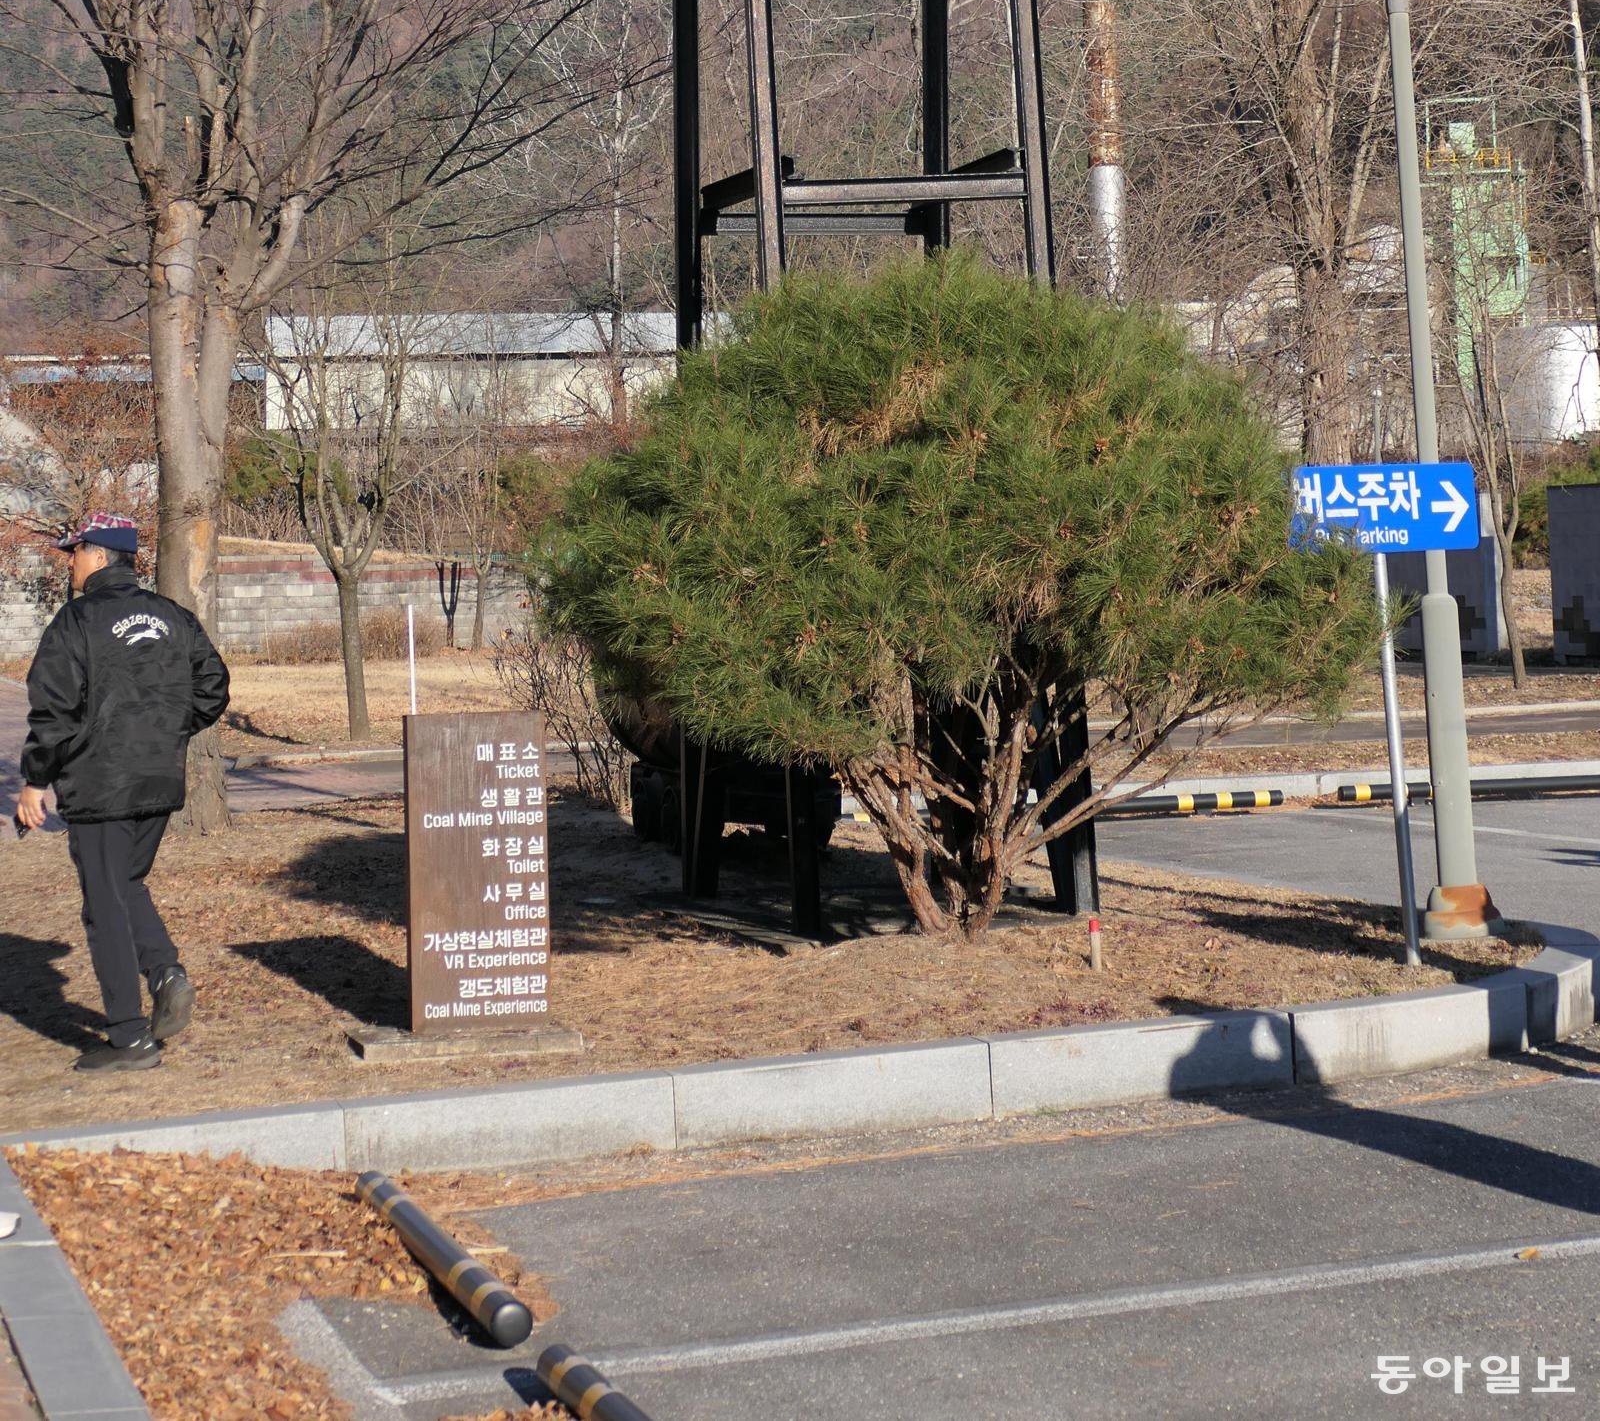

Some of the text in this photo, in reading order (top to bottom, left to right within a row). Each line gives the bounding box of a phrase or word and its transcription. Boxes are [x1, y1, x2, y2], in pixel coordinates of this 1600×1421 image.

[1293, 470, 1421, 523] 버스주차
[1356, 526, 1409, 545] arking
[111, 614, 169, 639] Slazenger
[495, 764, 540, 779] Ticket
[423, 809, 544, 829] Coal Mine Village
[506, 858, 545, 874] Toilet
[504, 904, 546, 920] Office
[423, 927, 548, 952] 가상현실체험관
[444, 951, 547, 969] VR Experience
[459, 974, 548, 998] 갱도체험관
[425, 999, 548, 1019] Coal Mine Experience
